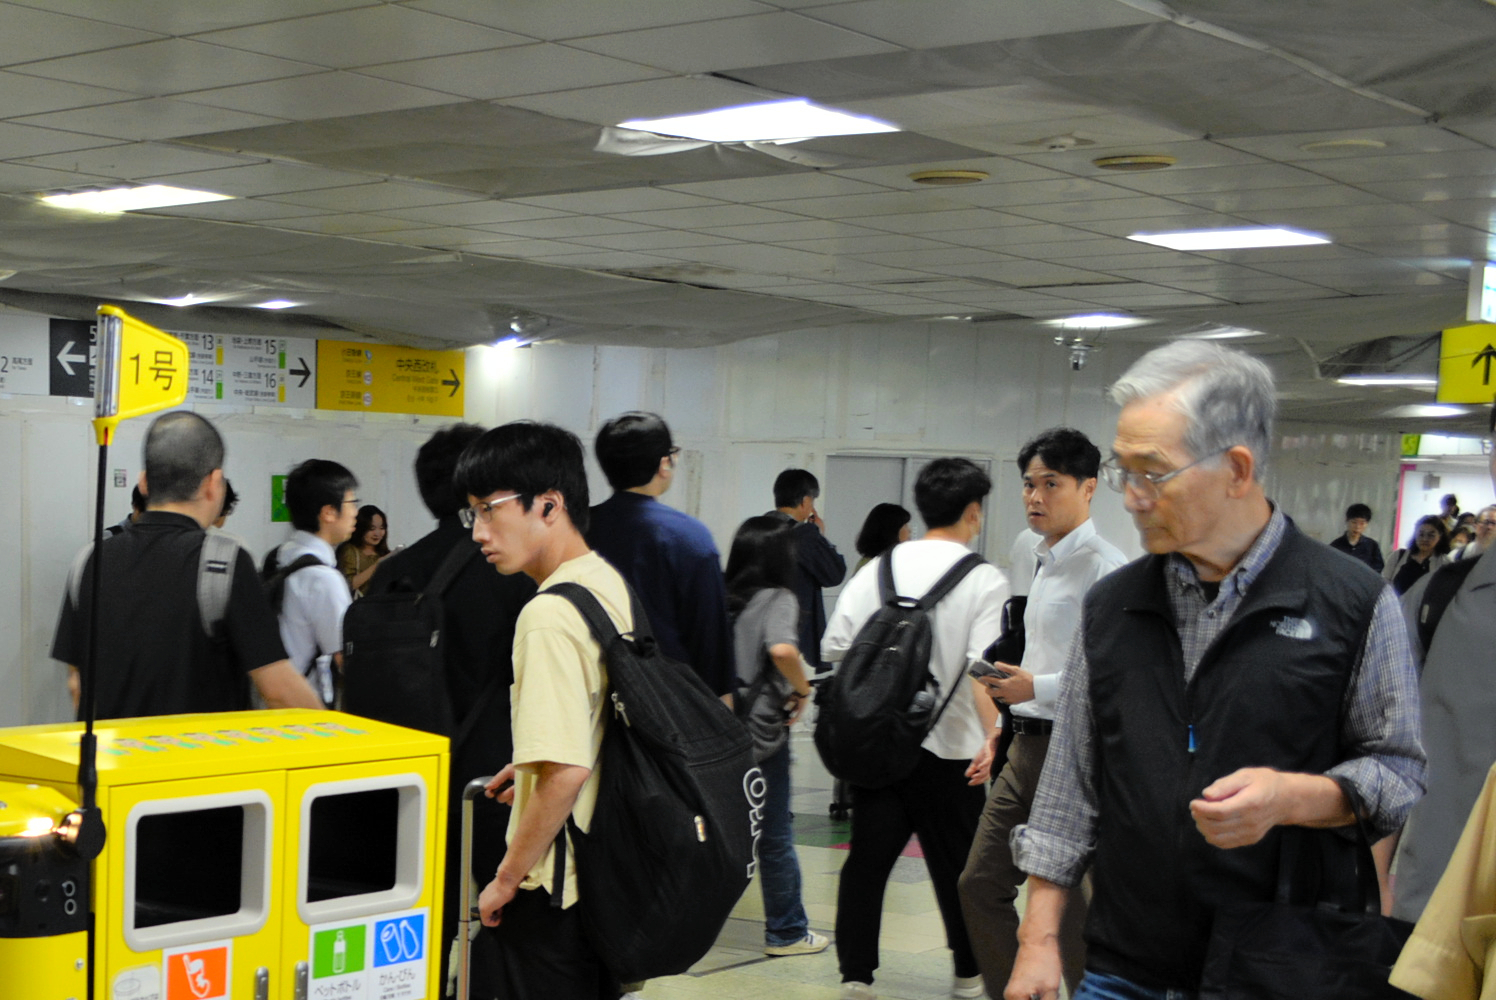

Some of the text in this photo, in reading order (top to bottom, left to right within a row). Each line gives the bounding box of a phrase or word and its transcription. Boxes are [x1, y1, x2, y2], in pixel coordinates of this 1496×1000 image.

[202, 334, 214, 351] 13
[265, 339, 277, 355] 15
[129, 350, 177, 392] 1号
[202, 369, 214, 385] 14
[265, 373, 277, 389] 16
[315, 979, 362, 997] ペットボトル
